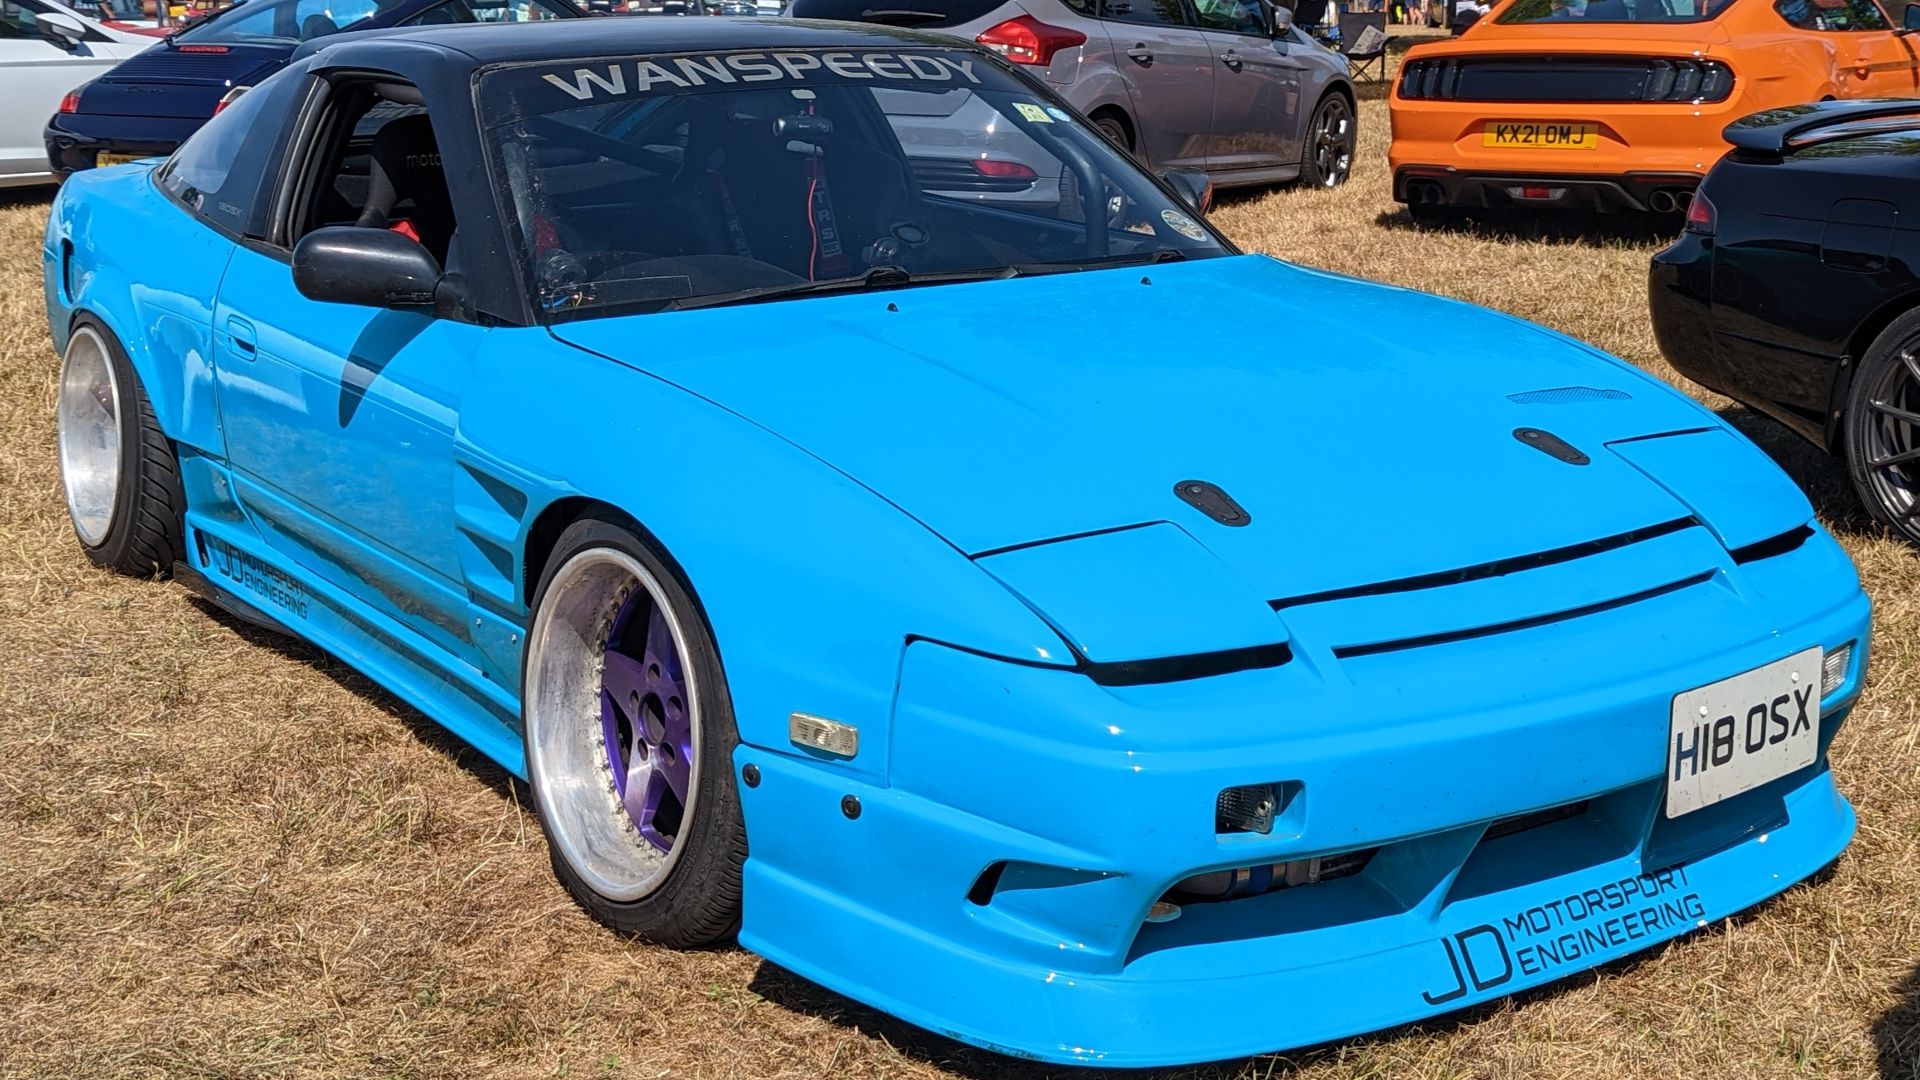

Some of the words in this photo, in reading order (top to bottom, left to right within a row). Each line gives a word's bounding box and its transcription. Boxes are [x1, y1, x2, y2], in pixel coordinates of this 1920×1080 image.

[542, 52, 982, 100] WANSPEEDY
[1495, 124, 1540, 143] KX21
[1545, 125, 1585, 144] OMJ
[241, 548, 306, 595] MOTORSPORT
[244, 571, 308, 620] ENGINEERING
[1502, 861, 1690, 943] MOTORSPORT
[1516, 893, 1706, 977] ENGINEERING
[1421, 923, 1514, 1006] JD
